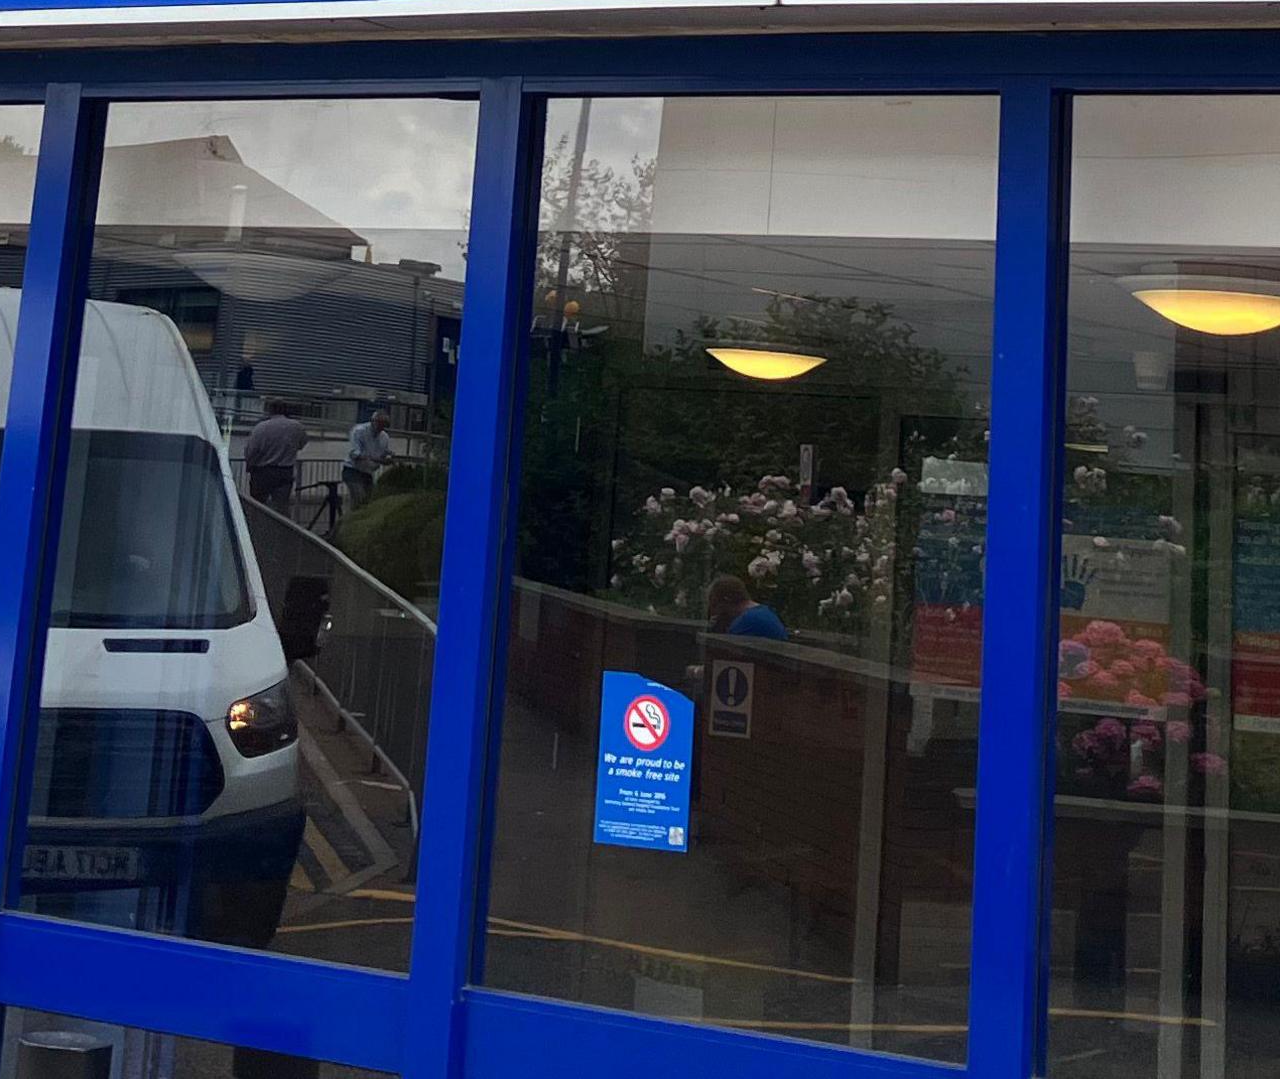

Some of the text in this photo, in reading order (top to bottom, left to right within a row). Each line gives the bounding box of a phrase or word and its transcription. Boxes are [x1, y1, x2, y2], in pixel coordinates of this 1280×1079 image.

[605, 753, 685, 770] We are proud to be
[608, 768, 680, 782] a smoke free site
